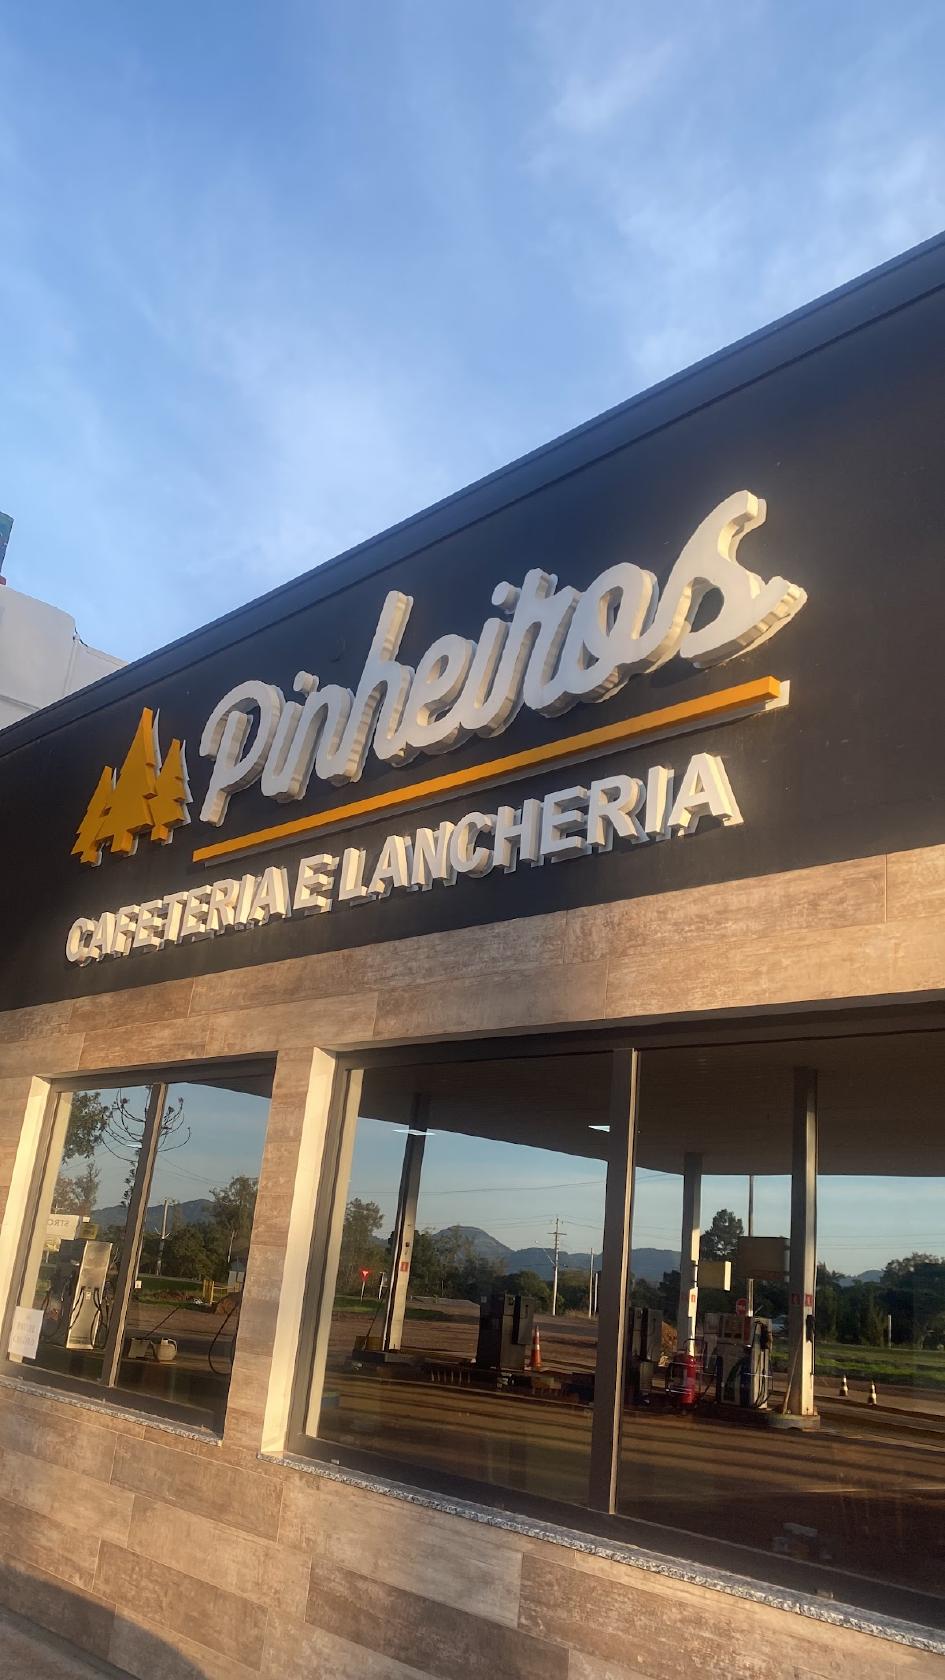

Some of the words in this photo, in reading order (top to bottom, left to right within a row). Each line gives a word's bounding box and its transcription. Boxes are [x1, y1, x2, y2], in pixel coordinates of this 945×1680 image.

[199, 489, 808, 827] Pinheiros
[65, 865, 292, 967] CAFETERIA
[292, 853, 340, 916] E
[338, 752, 744, 908] LANCHERIA
